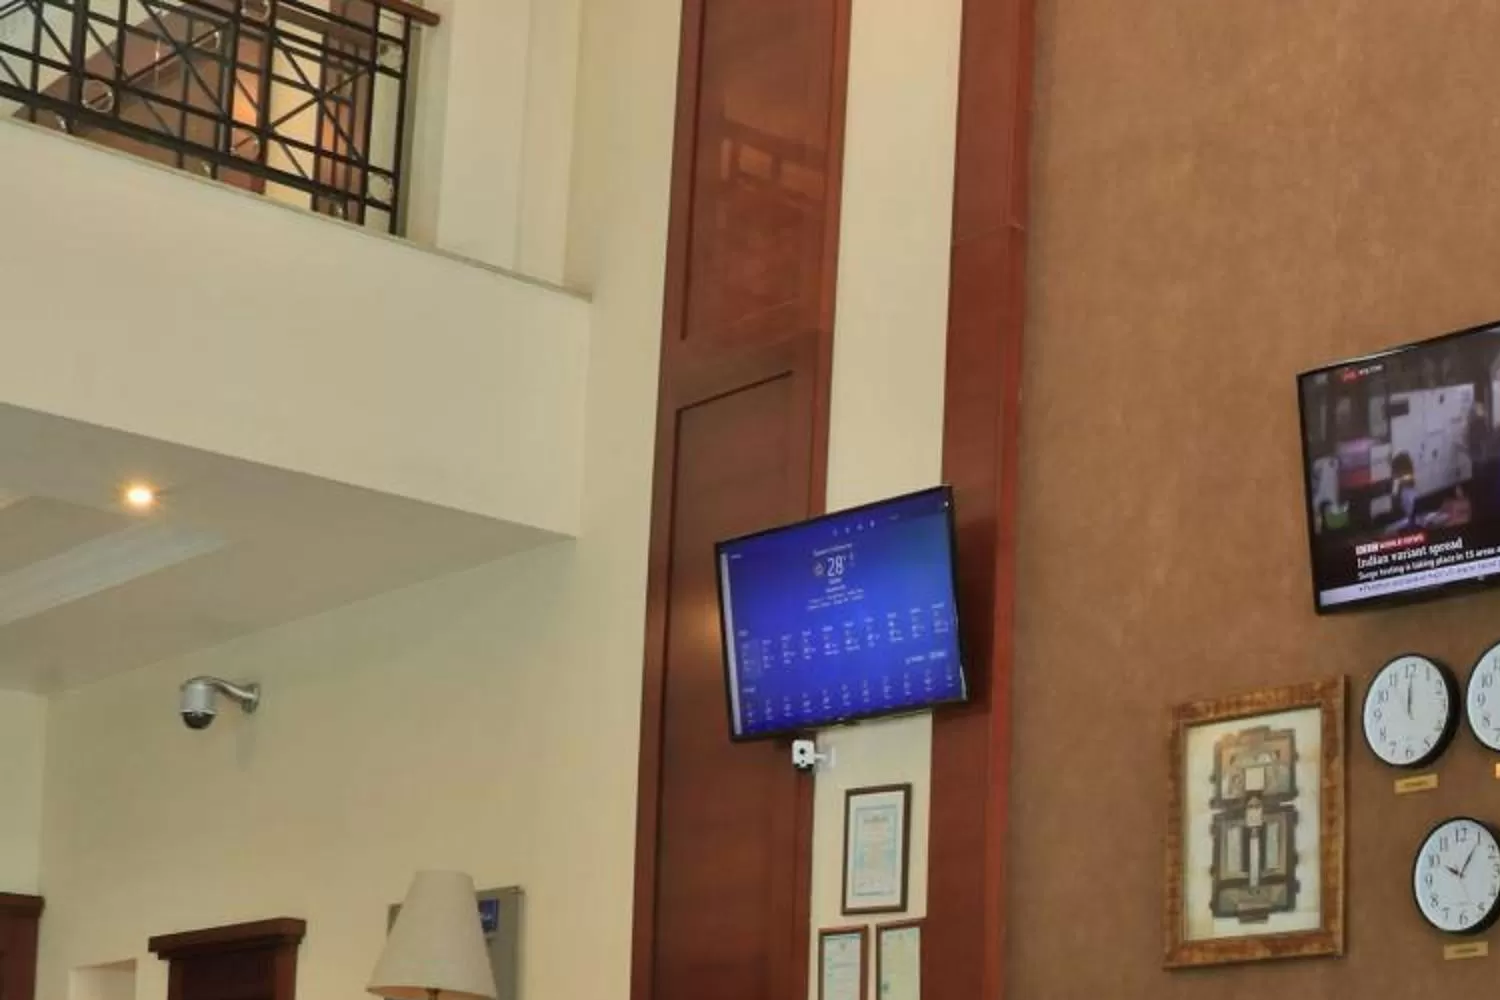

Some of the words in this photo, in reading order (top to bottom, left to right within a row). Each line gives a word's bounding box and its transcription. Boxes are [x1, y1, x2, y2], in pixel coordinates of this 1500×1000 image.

[1357, 554, 1389, 569] Indian
[1391, 546, 1426, 563] variant
[1429, 537, 1463, 556] spread
[1436, 553, 1455, 567] place
[1405, 664, 1416, 679] 12
[1426, 667, 1430, 681] 1
[1388, 672, 1398, 688] 11
[1481, 673, 1493, 688] 10
[1378, 689, 1389, 703] 10
[1478, 692, 1486, 706] 9
[1374, 708, 1382, 722] 9
[1482, 712, 1490, 727] 8
[1380, 726, 1387, 742] 8
[1493, 728, 1500, 742] 7
[1390, 740, 1397, 756] 7
[1405, 745, 1413, 759] 6
[1455, 827, 1467, 843] 12
[1477, 831, 1481, 844] 1
[1439, 837, 1449, 852] 11
[1428, 853, 1440, 867] 10
[1492, 863, 1500, 878] 3
[1425, 874, 1433, 888] 9
[1430, 895, 1439, 909] 8
[1477, 902, 1485, 914] 5
[1442, 907, 1450, 920] 7
[1459, 911, 1468, 925] 6
